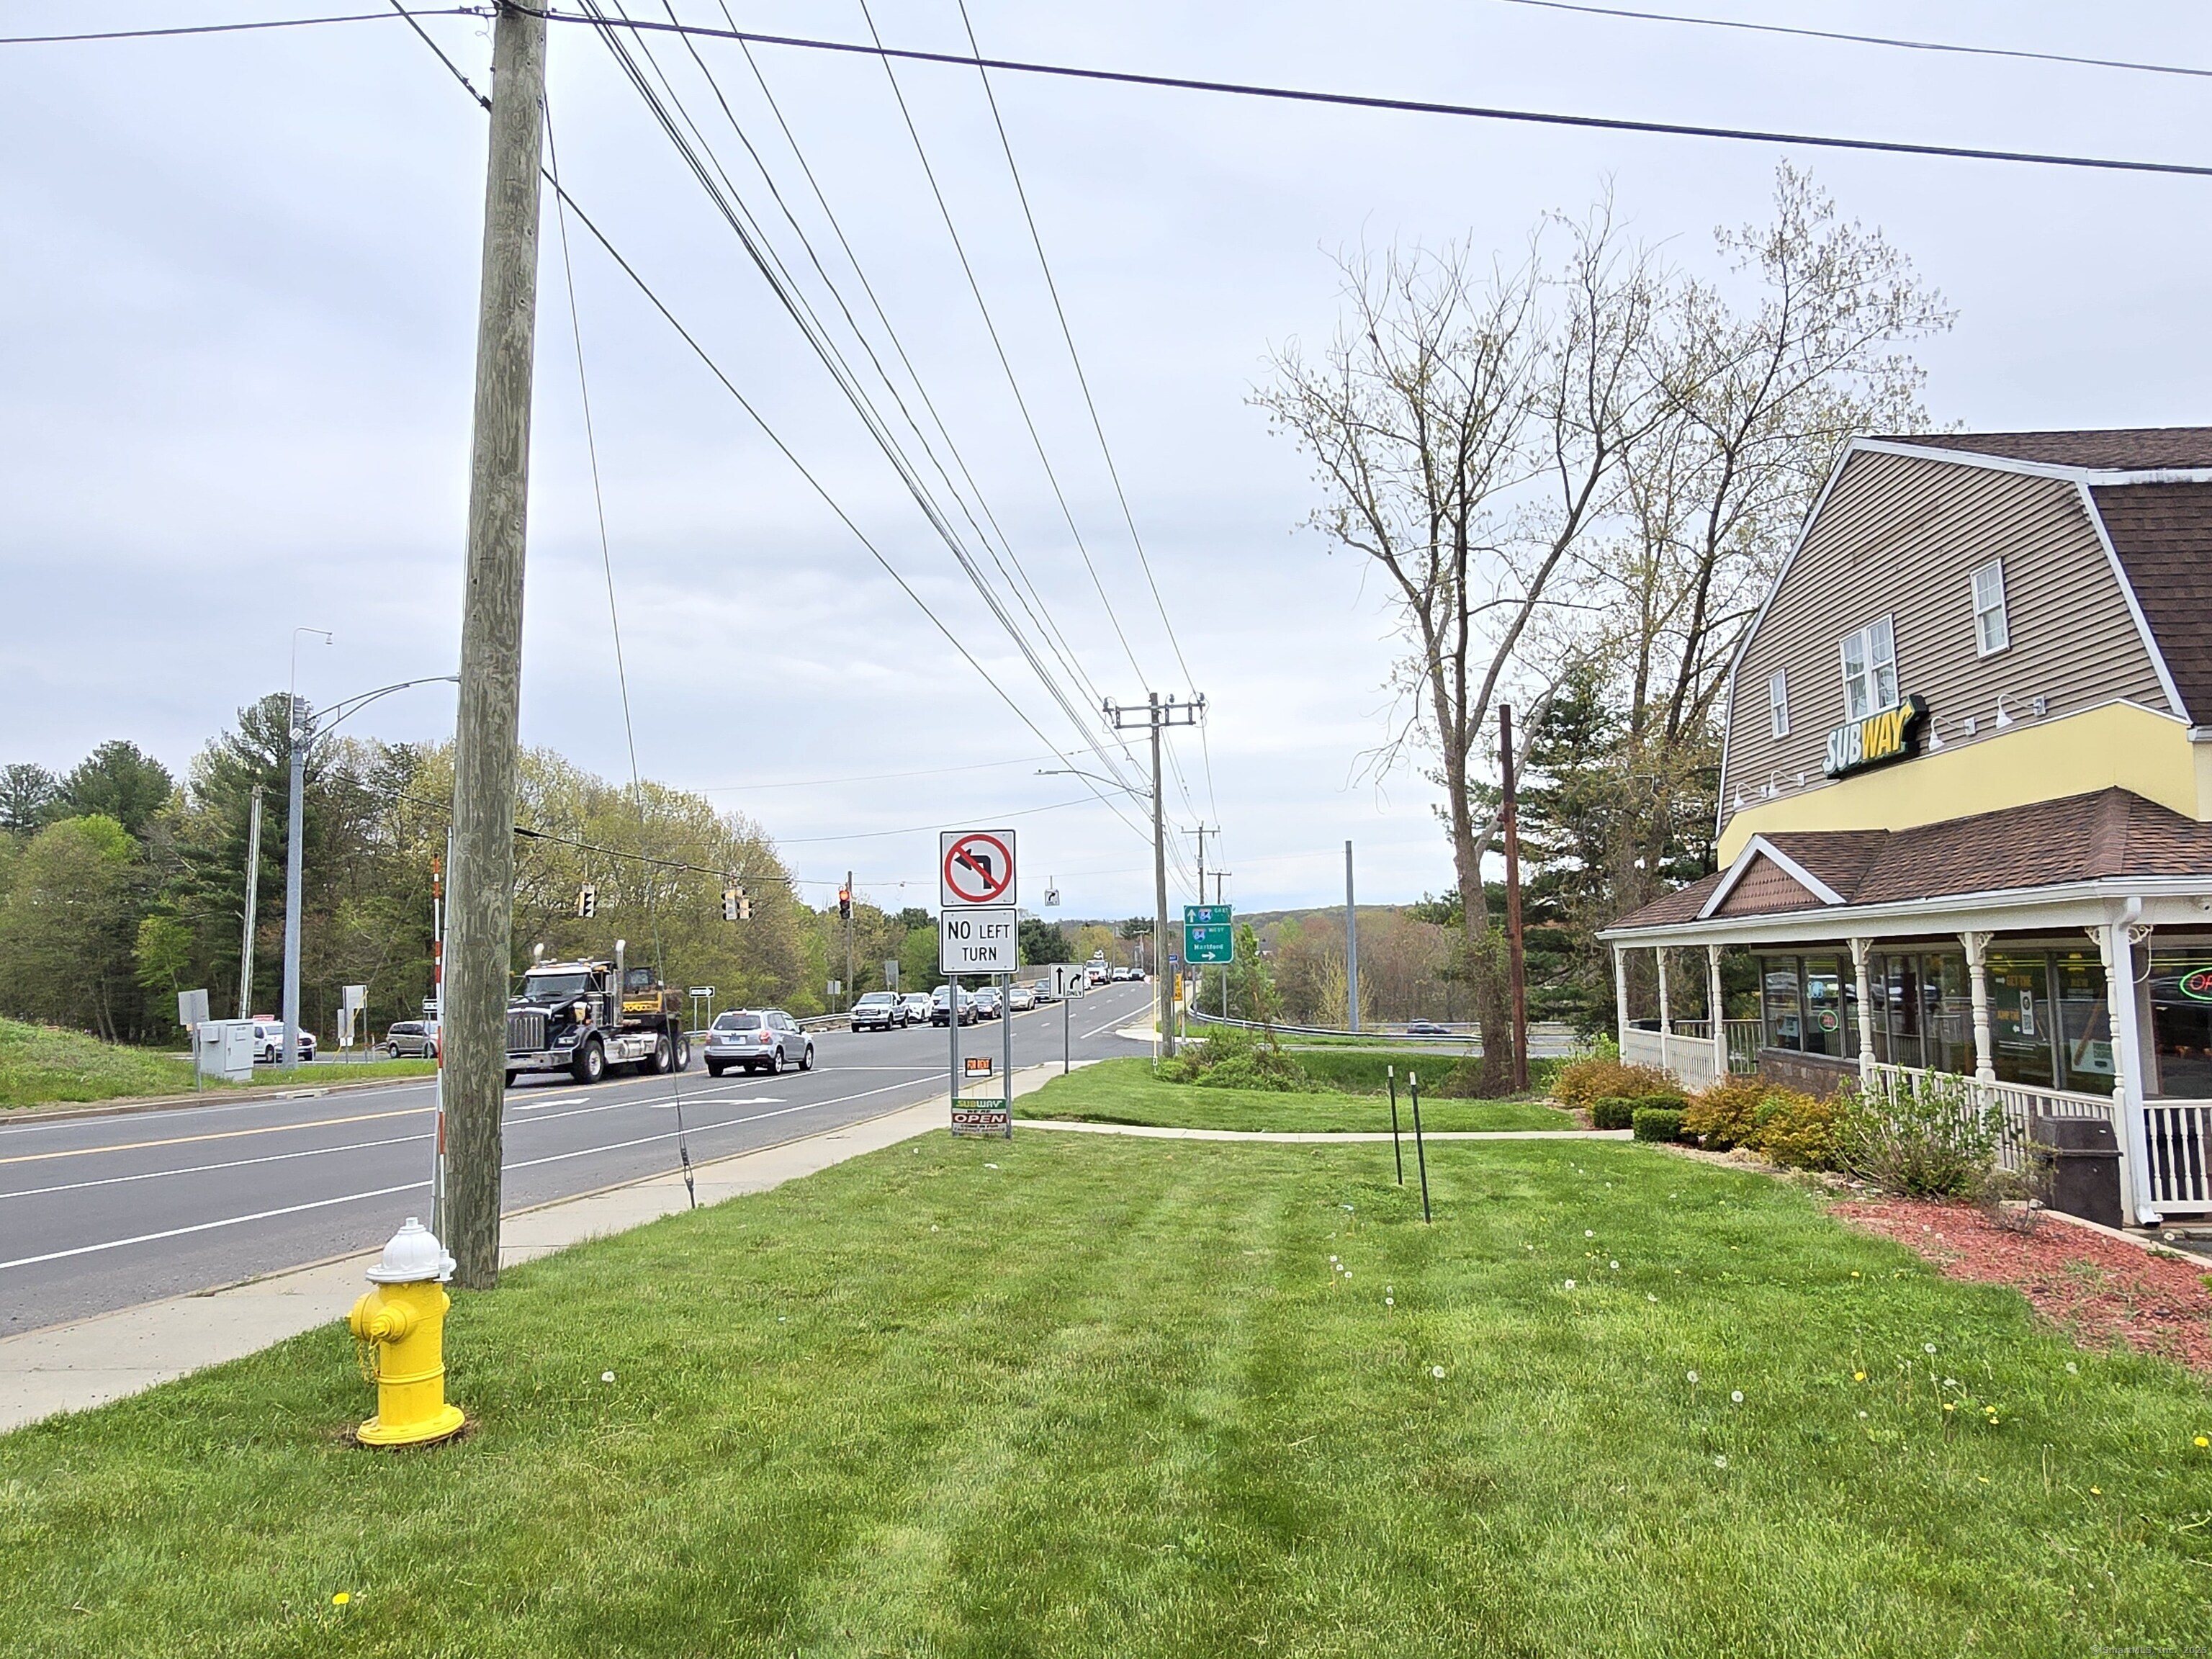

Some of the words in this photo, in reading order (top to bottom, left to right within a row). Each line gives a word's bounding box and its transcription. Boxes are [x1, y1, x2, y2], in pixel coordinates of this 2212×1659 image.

[1822, 700, 1913, 773] SUBWAY
[948, 921, 971, 940] NO
[979, 925, 1010, 939] LEFT
[962, 947, 997, 961] TURN
